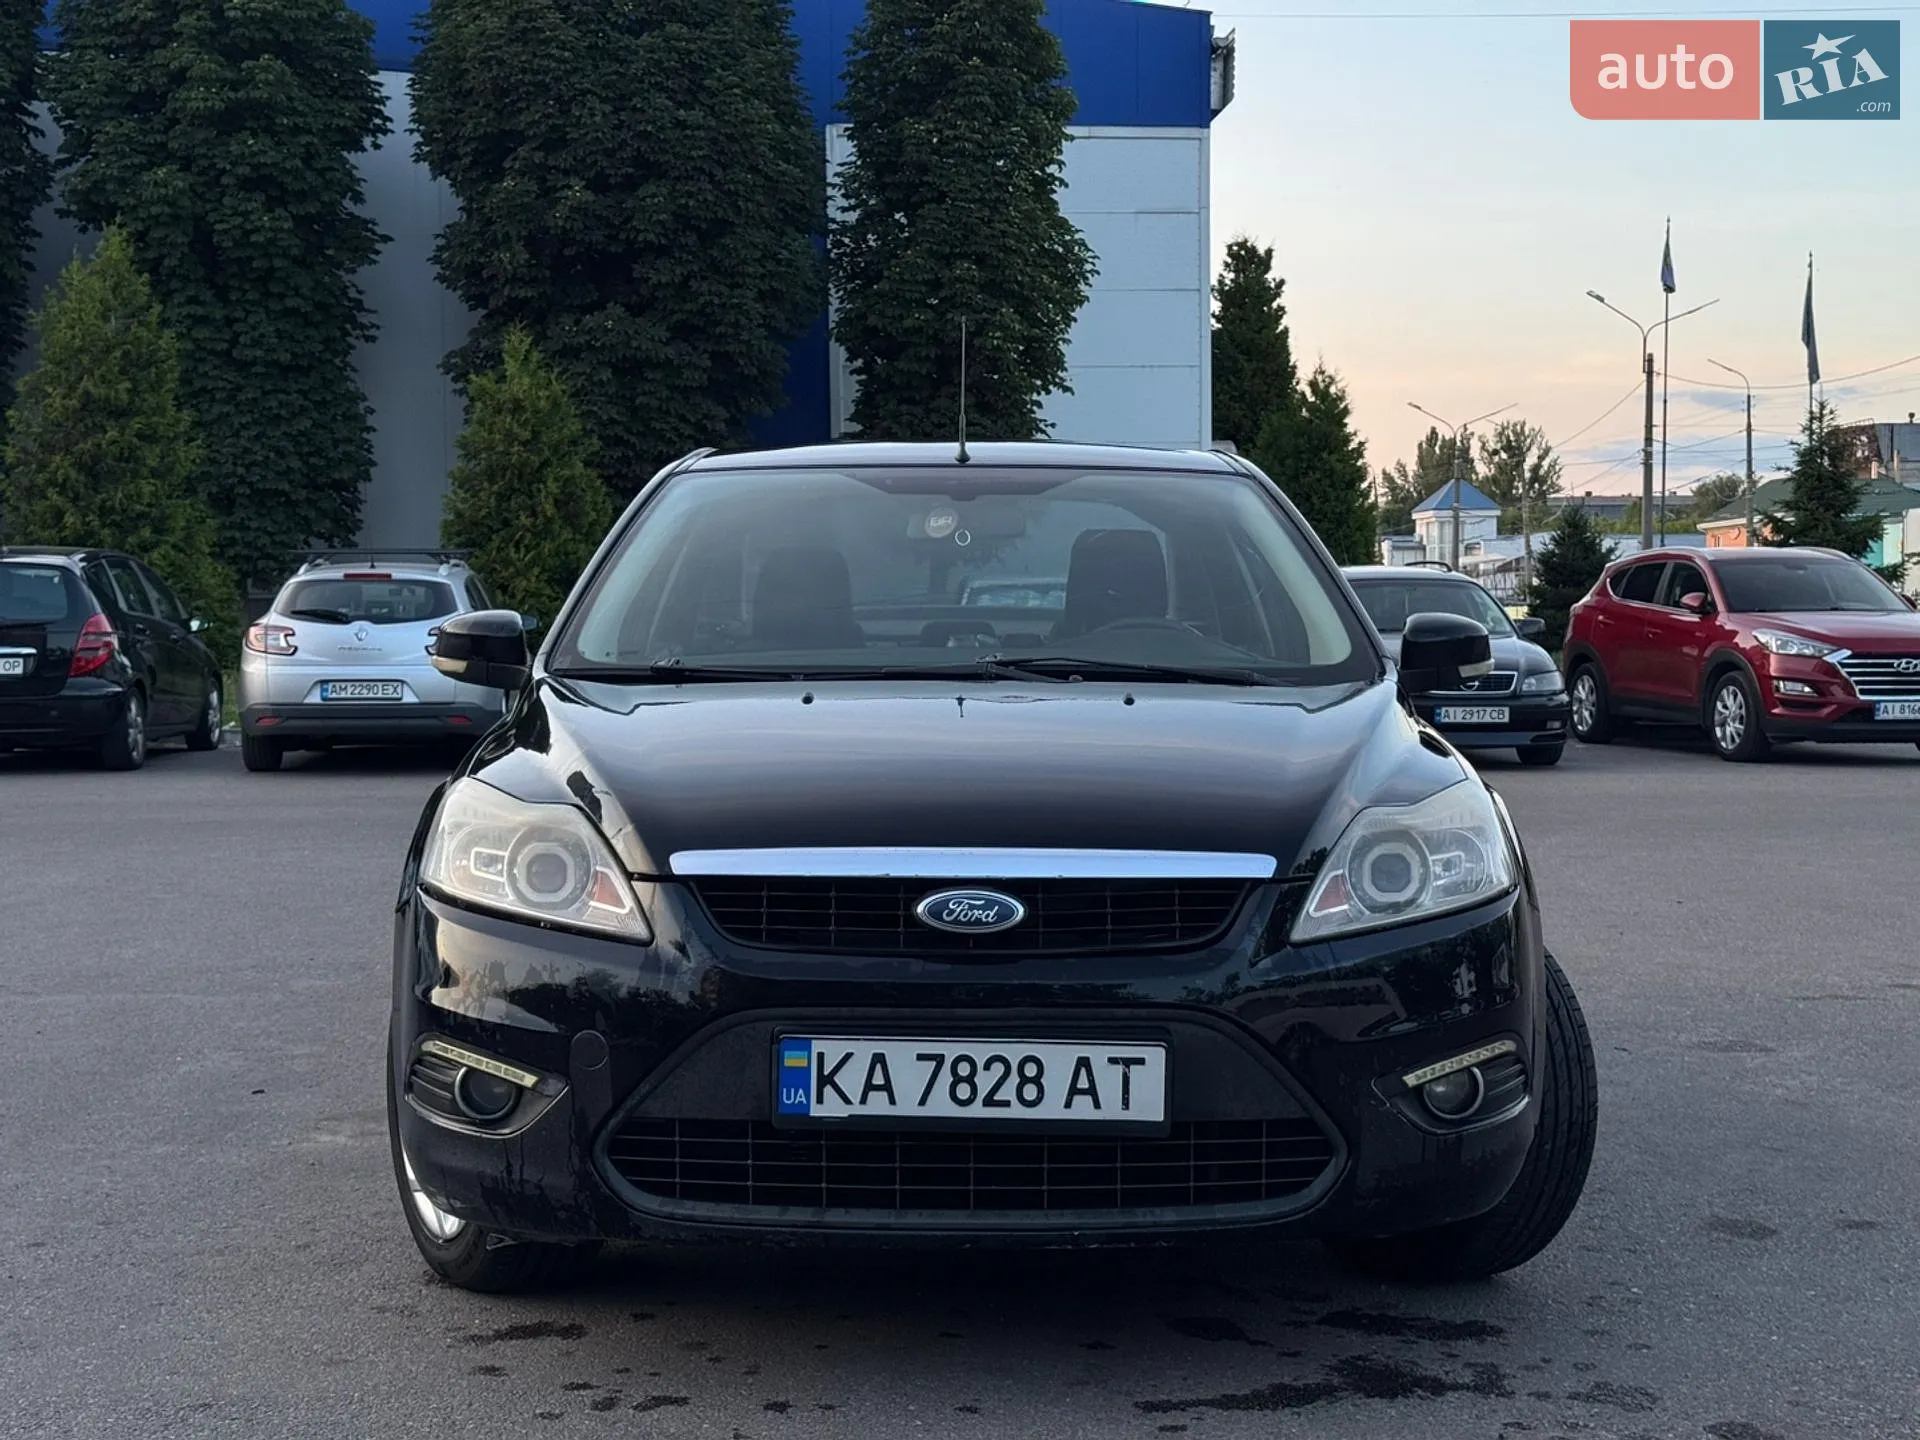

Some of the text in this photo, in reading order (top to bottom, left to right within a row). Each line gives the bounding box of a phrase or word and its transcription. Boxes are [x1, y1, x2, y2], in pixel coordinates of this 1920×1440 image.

[330, 683, 400, 696] AM 2290 EX
[1461, 709, 1487, 720] 2917
[1489, 709, 1506, 720] CB
[942, 898, 999, 922] Ford
[816, 1051, 1146, 1111] KA 7828 AT
[782, 1087, 807, 1105] UA
